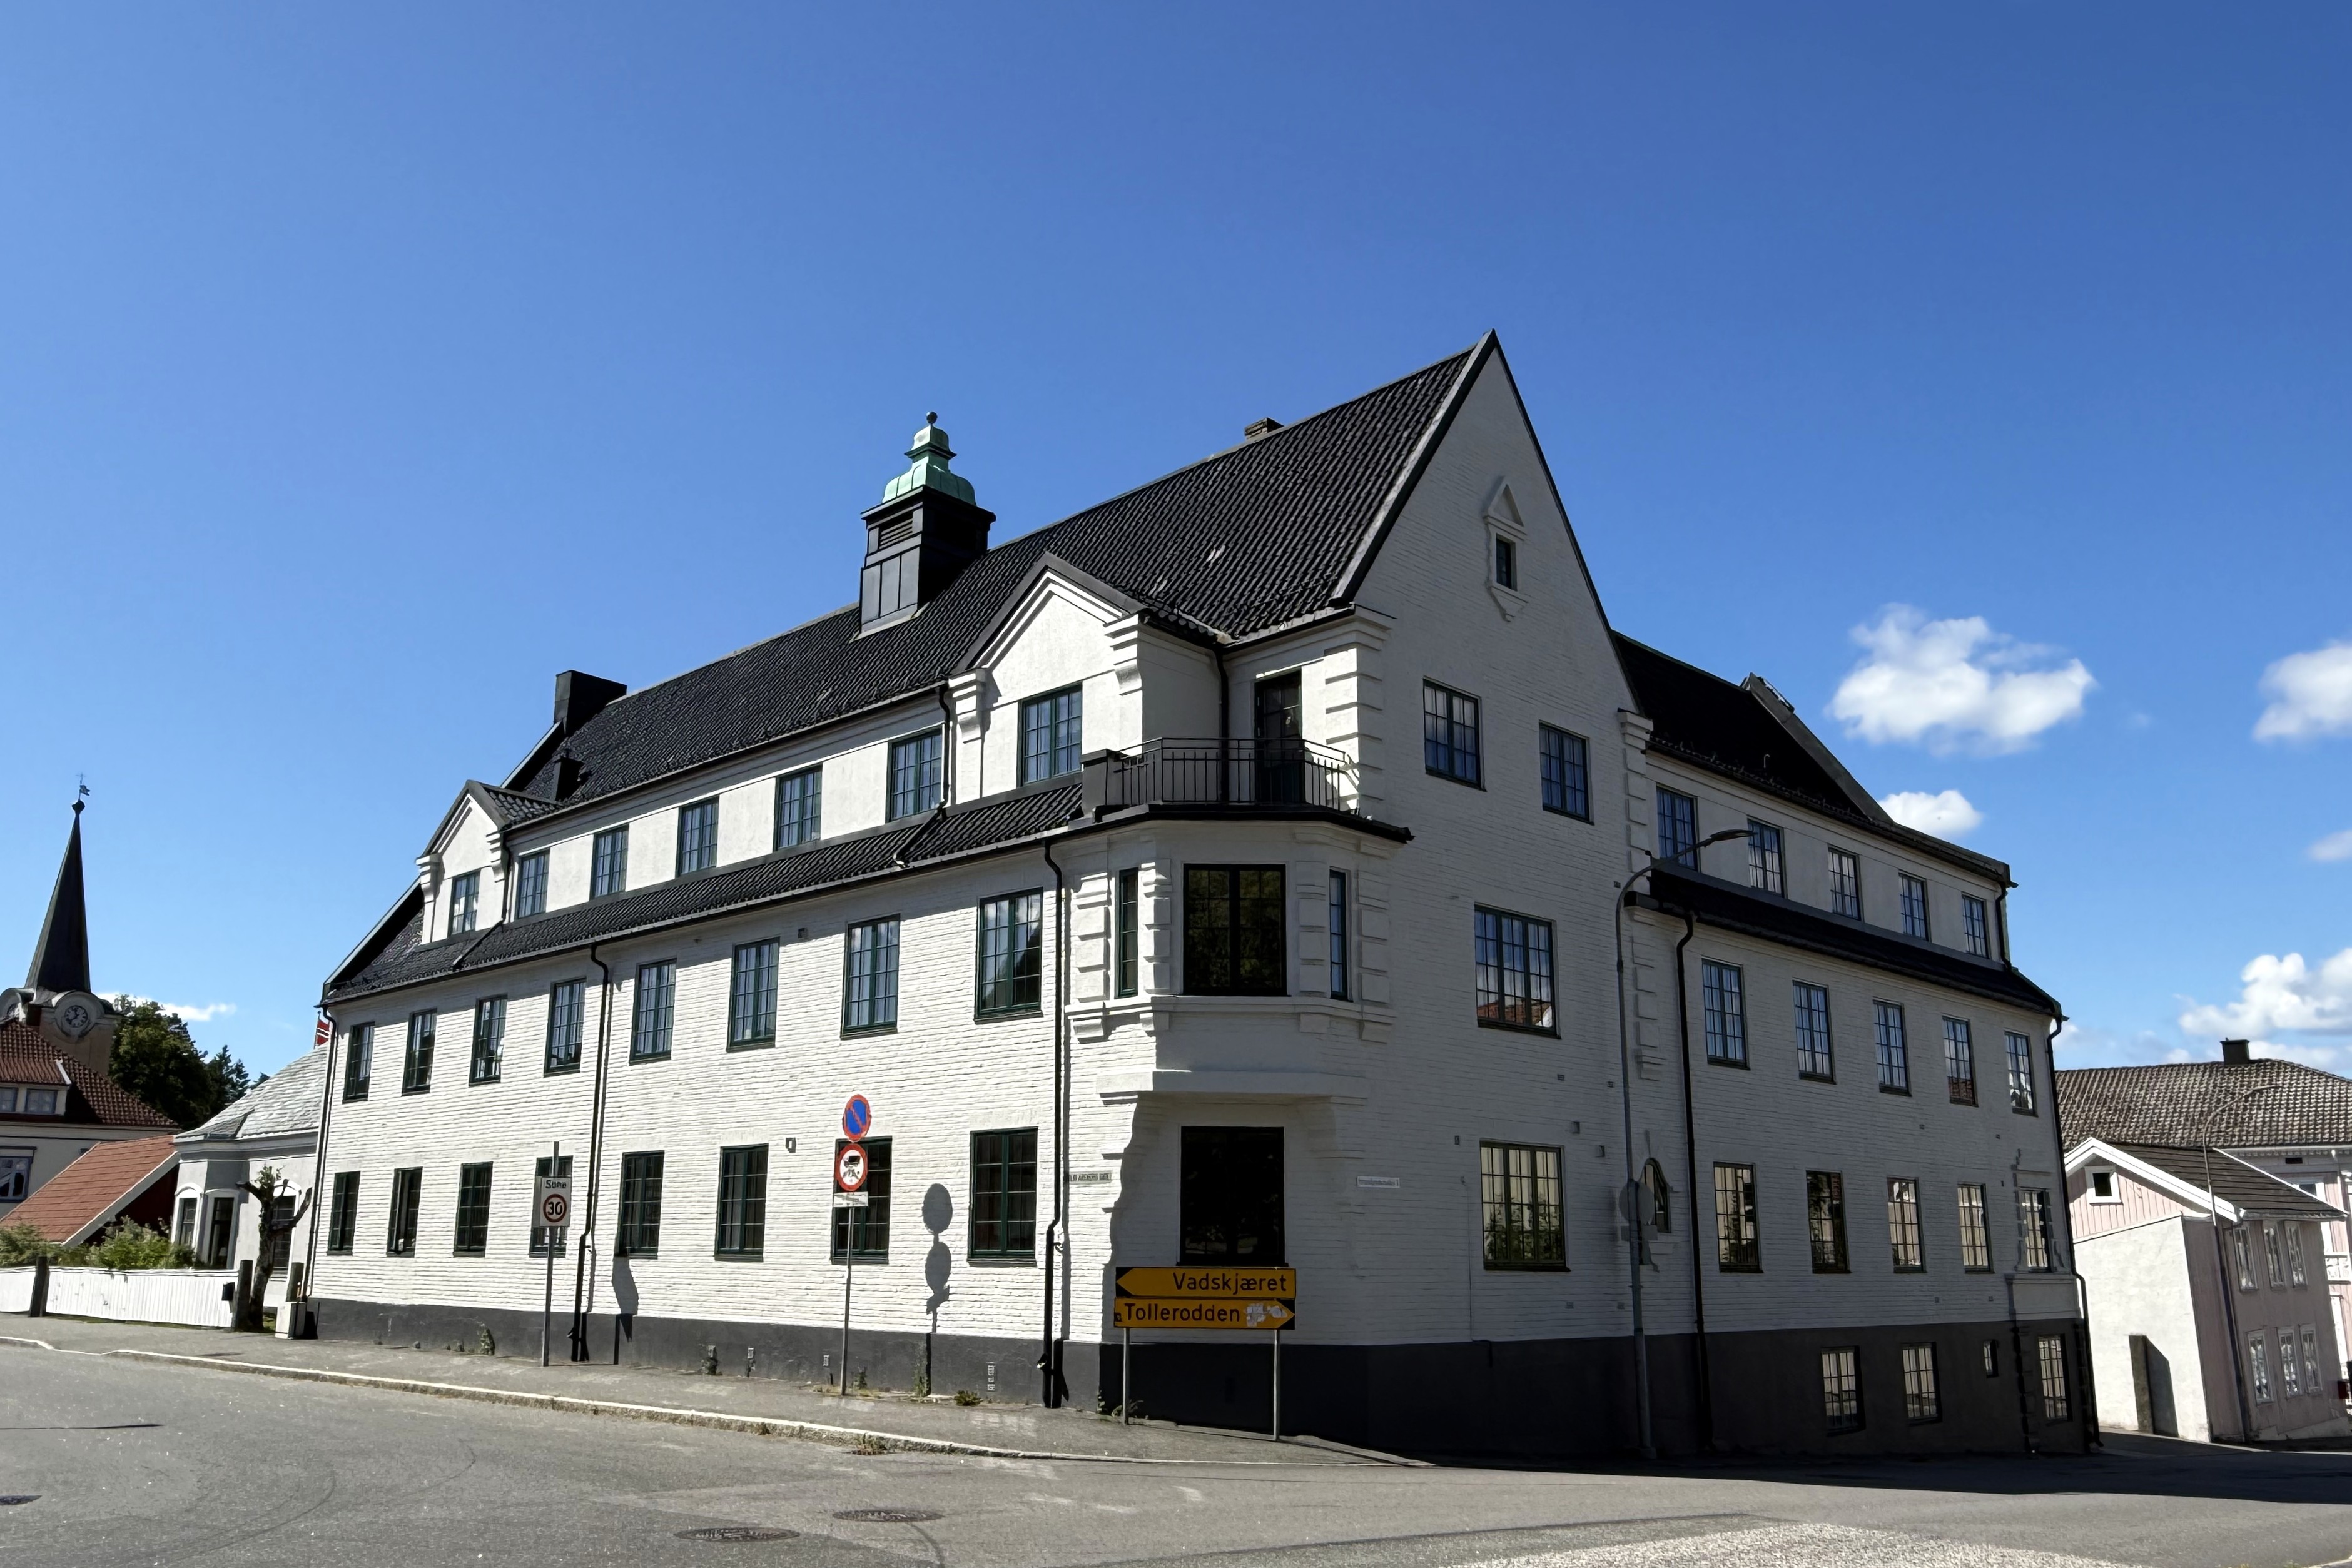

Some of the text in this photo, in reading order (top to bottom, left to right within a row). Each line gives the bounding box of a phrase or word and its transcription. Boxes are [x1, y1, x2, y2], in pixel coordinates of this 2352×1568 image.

[547, 1201, 562, 1215] 30
[1173, 1273, 1287, 1295] Vadskjæret
[1124, 1303, 1240, 1322] Tollerodden
